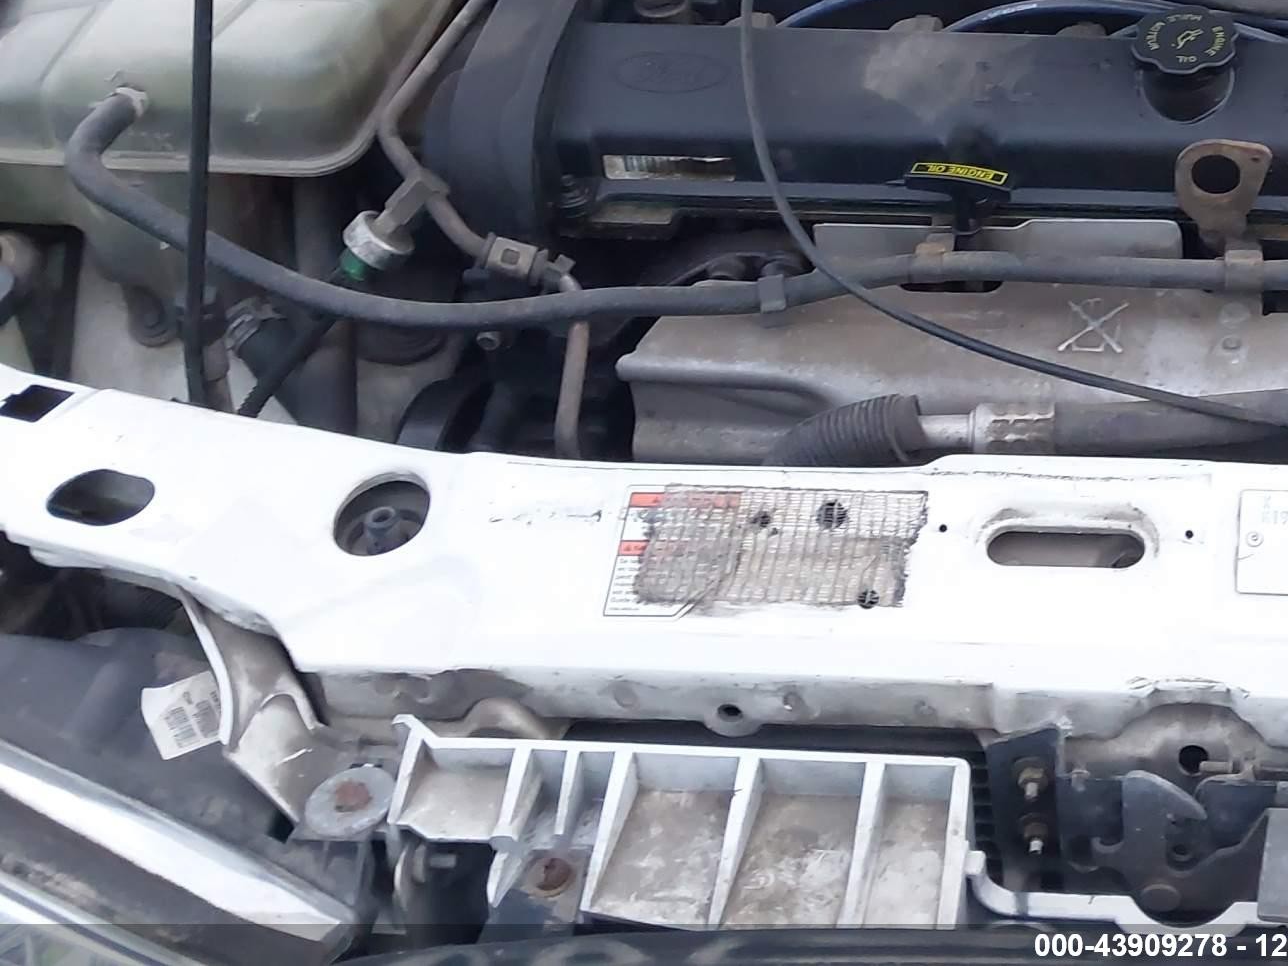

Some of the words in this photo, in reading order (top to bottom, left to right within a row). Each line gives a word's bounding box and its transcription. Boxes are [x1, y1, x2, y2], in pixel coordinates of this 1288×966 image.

[1205, 26, 1225, 56] ENGINE
[1176, 55, 1198, 63] OIL
[926, 164, 946, 172] OIL
[950, 167, 994, 180] ENGINE
